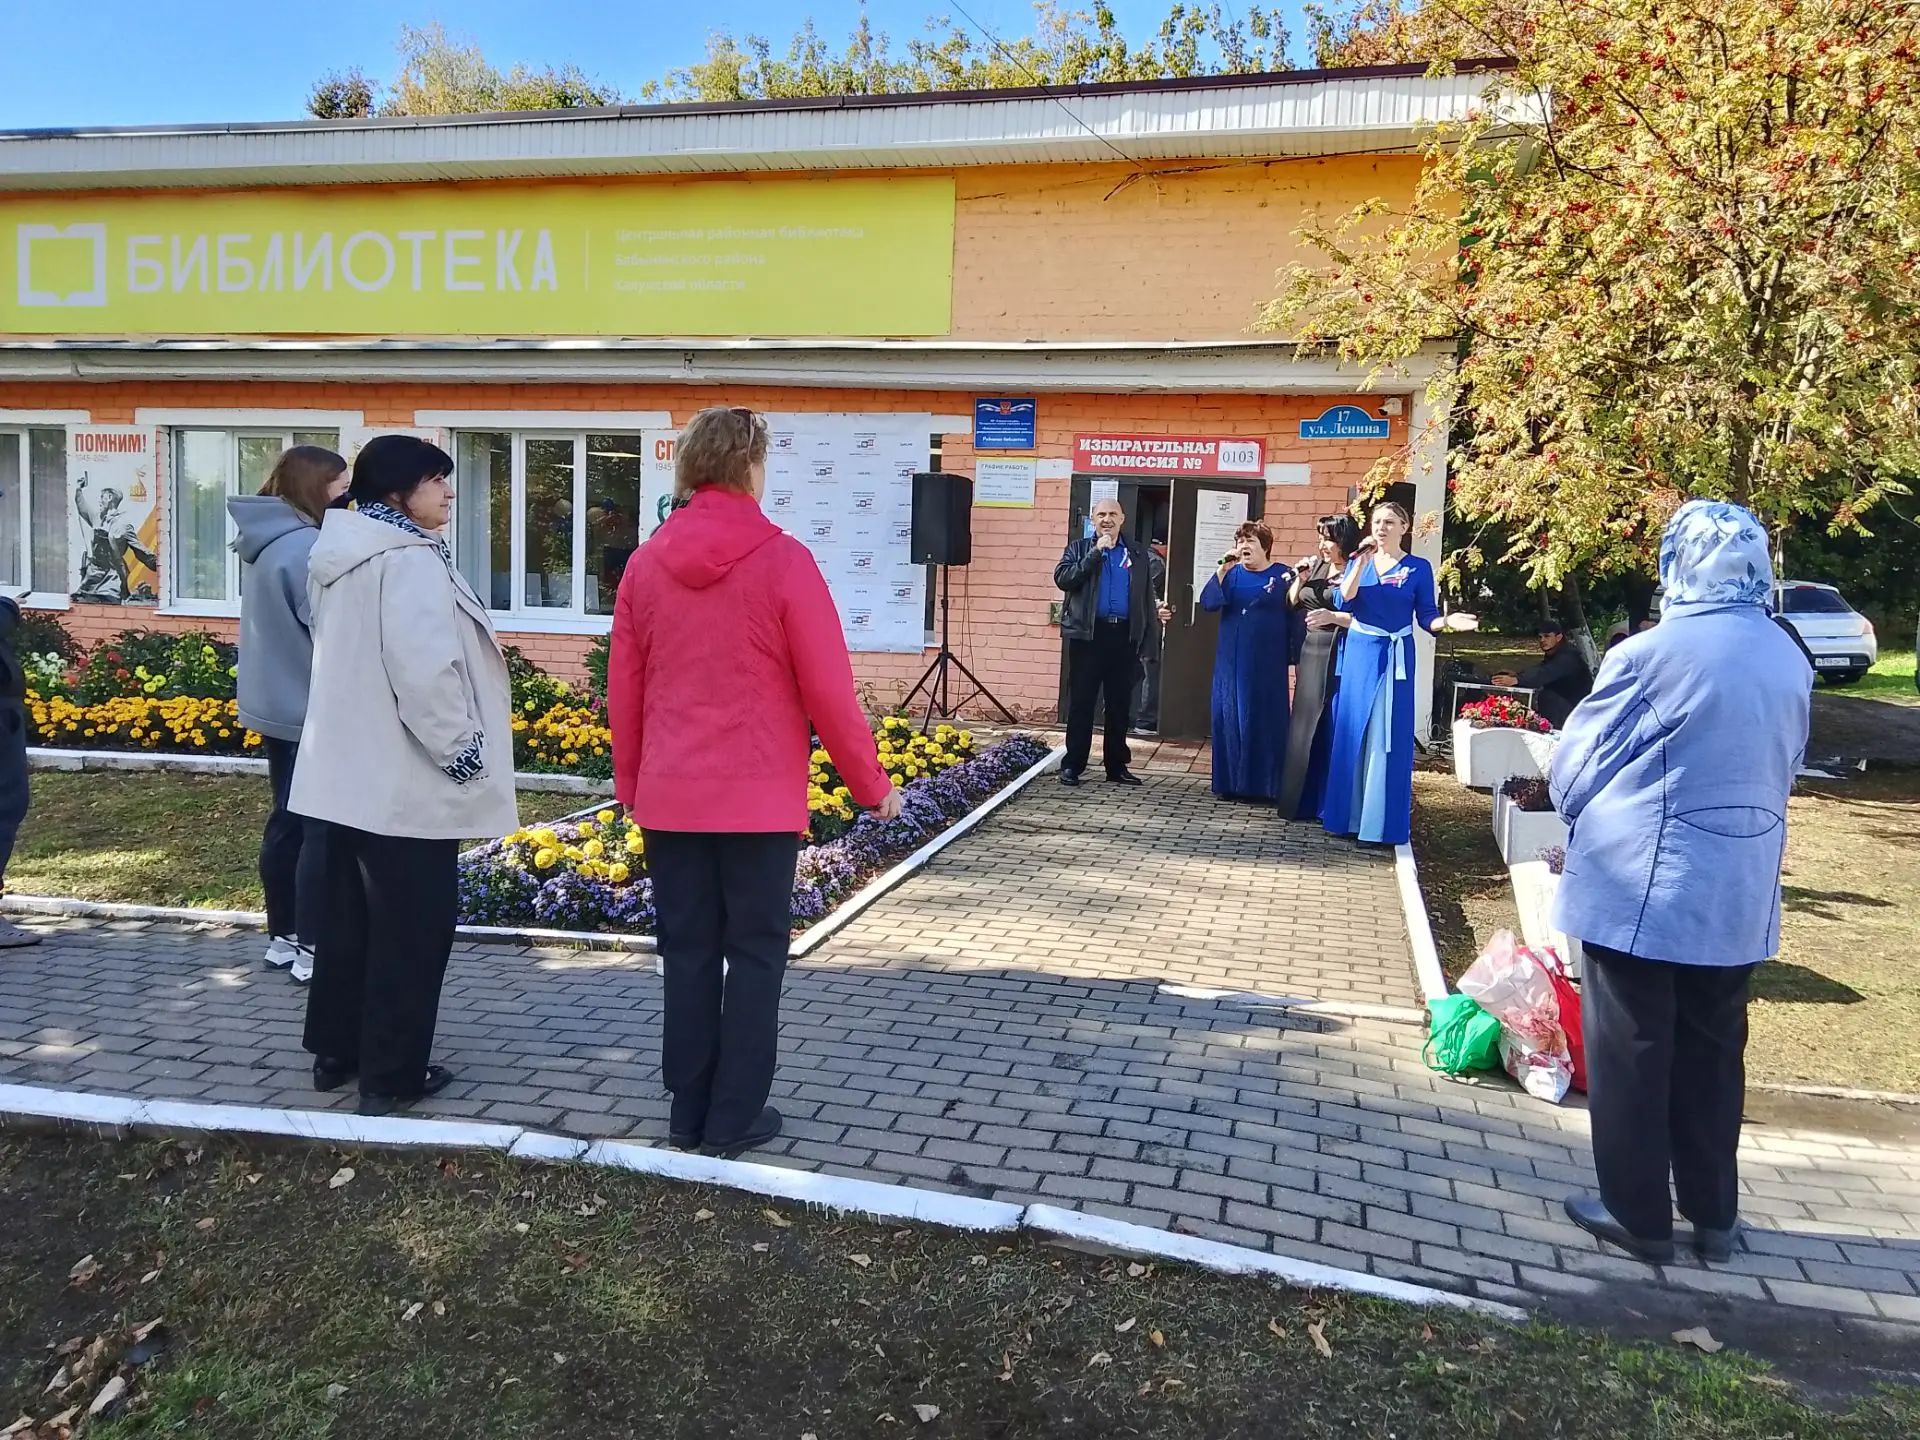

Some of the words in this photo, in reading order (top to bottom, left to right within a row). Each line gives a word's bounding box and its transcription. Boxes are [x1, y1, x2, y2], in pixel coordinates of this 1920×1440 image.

[127, 229, 560, 293] БИБЛИОТЕКА
[1338, 410, 1350, 422] 17
[1308, 425, 1327, 437] ул.
[1330, 422, 1380, 434] Ленина
[74, 433, 147, 453] ПОМНИМ!
[655, 440, 676, 460] СП
[1079, 438, 1216, 455] ИЗБИРАТЕЛЬНАЯ
[1090, 454, 1179, 468] КОМИССИЯ
[1183, 456, 1202, 470] №
[1222, 450, 1254, 463] 0103
